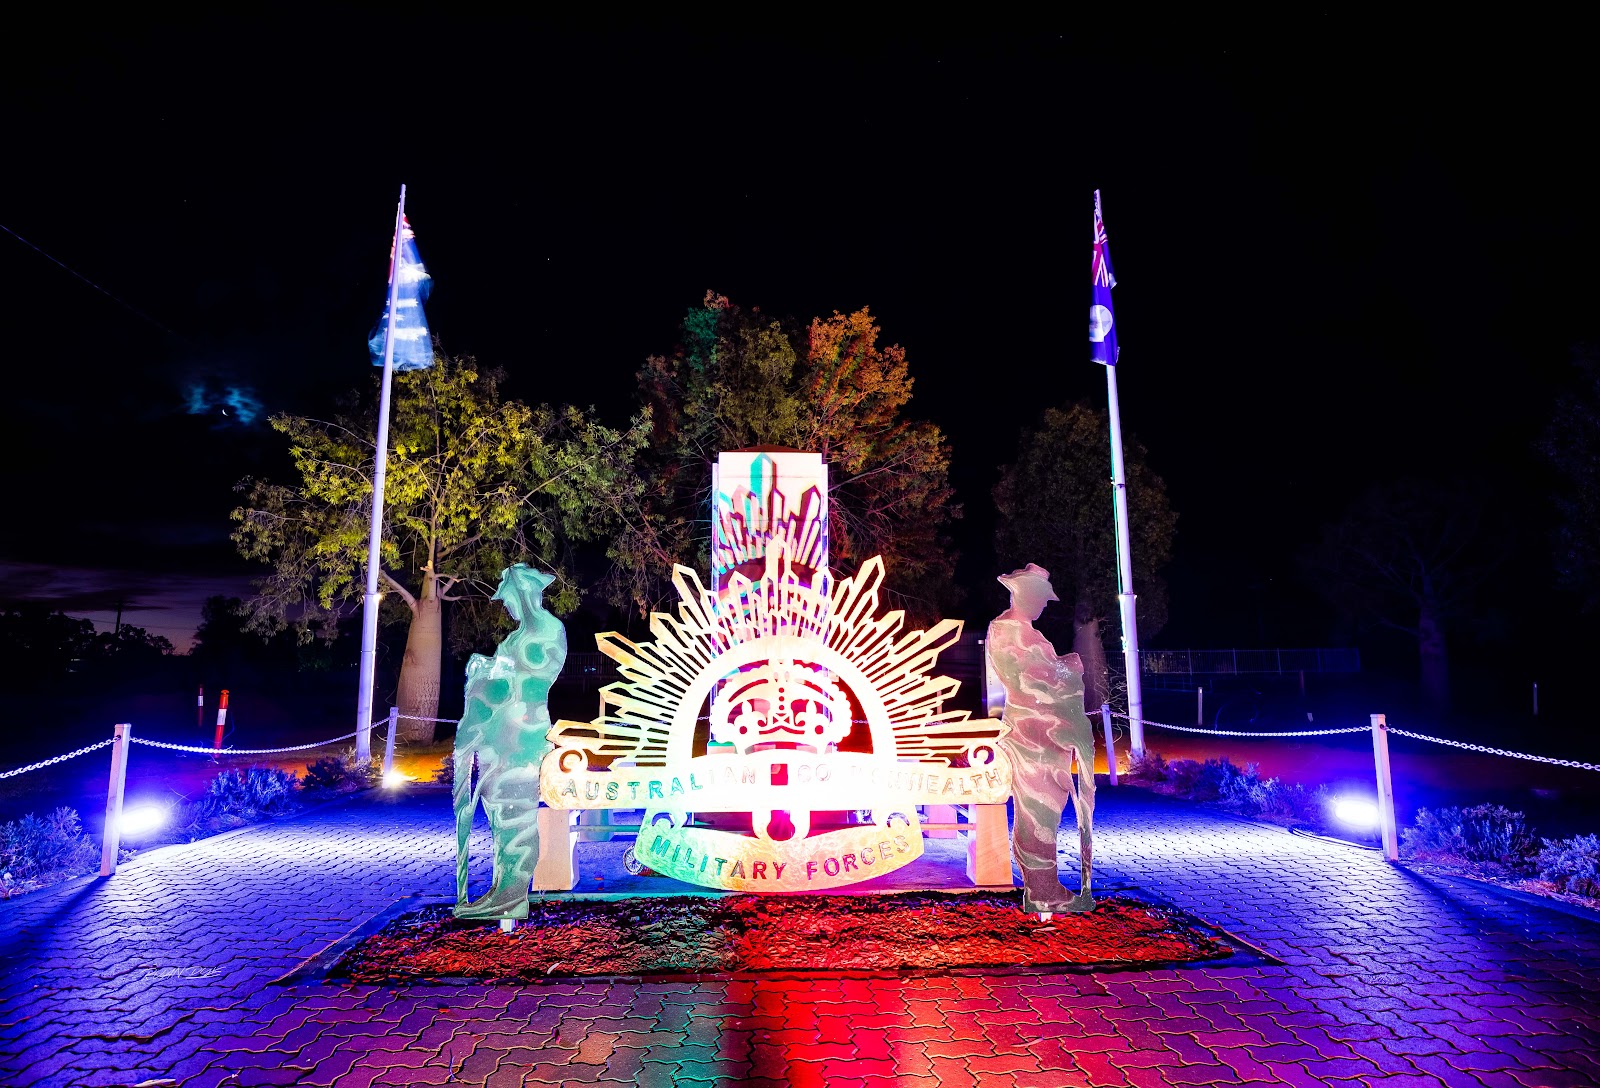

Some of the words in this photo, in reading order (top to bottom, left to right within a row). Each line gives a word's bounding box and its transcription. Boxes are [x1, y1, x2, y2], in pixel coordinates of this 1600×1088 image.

[561, 766, 756, 801] AUSTRALIAN
[797, 763, 1003, 796] COONWEALTH
[650, 835, 788, 880] MILITARY
[806, 834, 910, 881] FORCES
